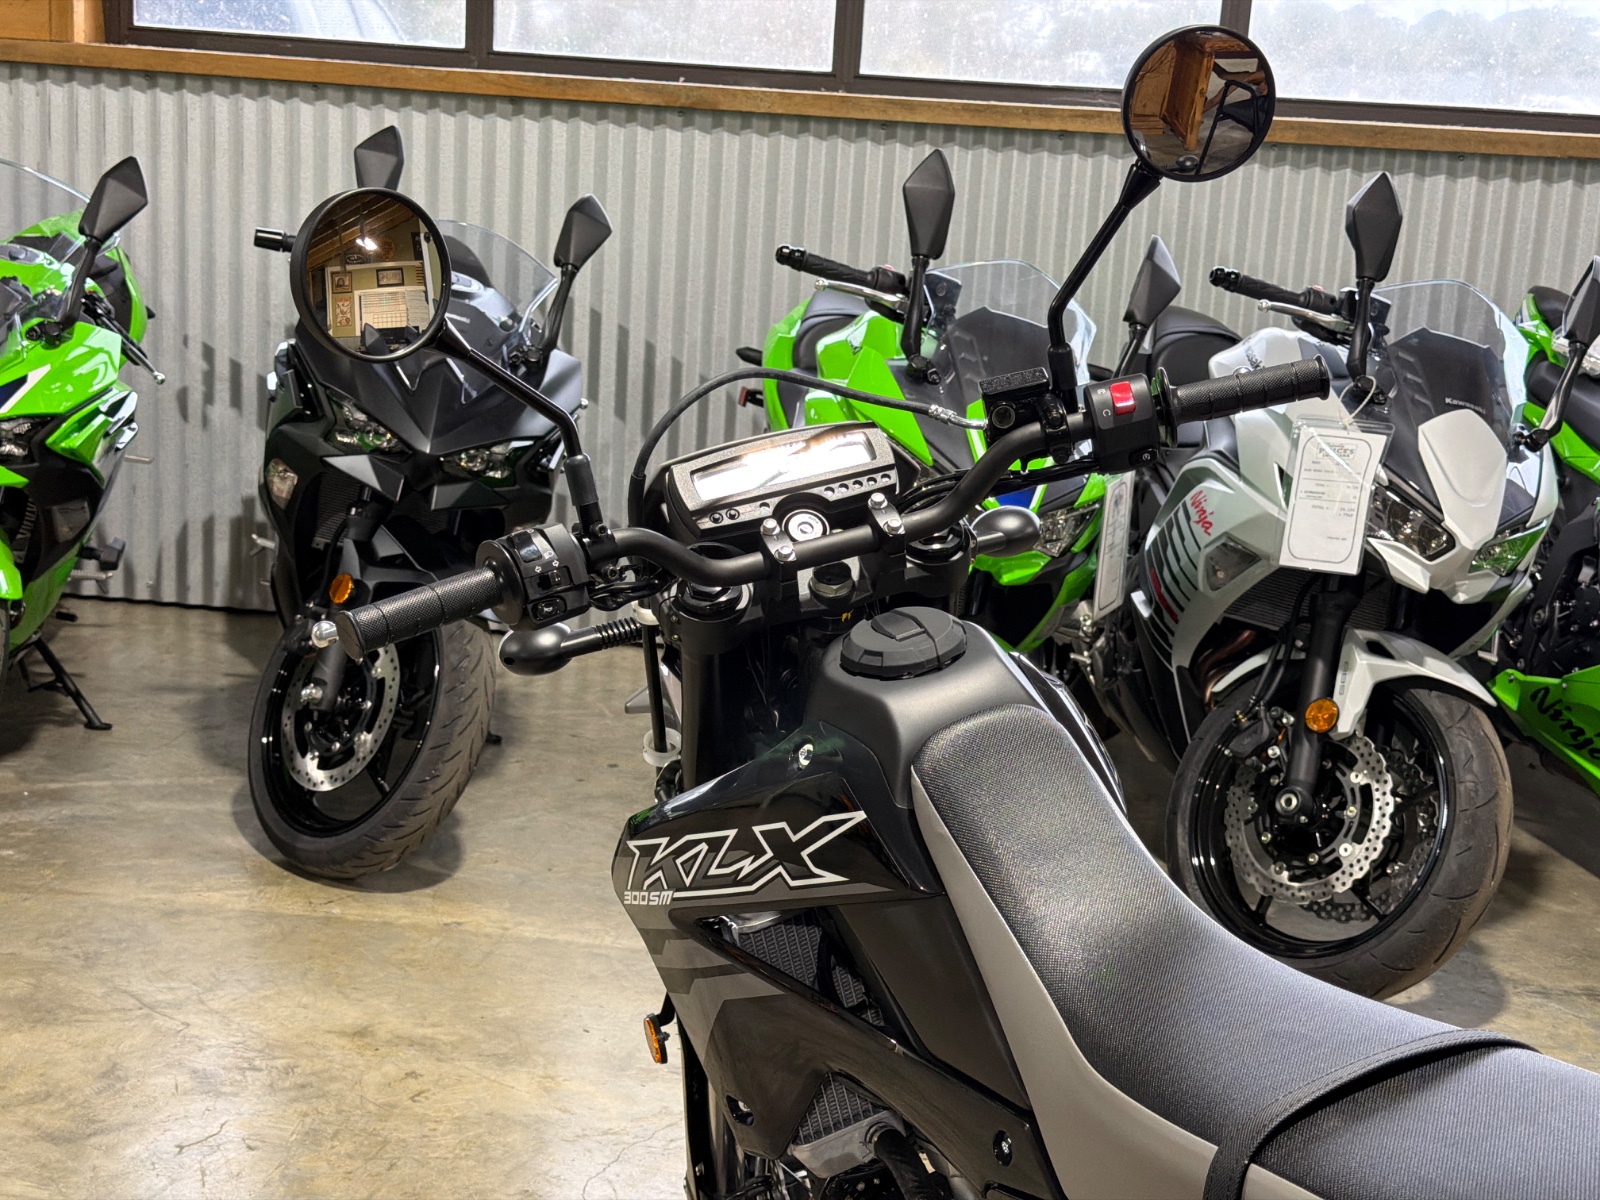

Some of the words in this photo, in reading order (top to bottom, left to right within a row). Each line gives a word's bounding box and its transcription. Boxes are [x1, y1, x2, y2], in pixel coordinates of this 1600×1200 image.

[1445, 397, 1486, 415] Kawasaki
[1190, 490, 1215, 536] Ninja
[626, 810, 867, 893] KLX
[623, 890, 673, 906] 300SM
